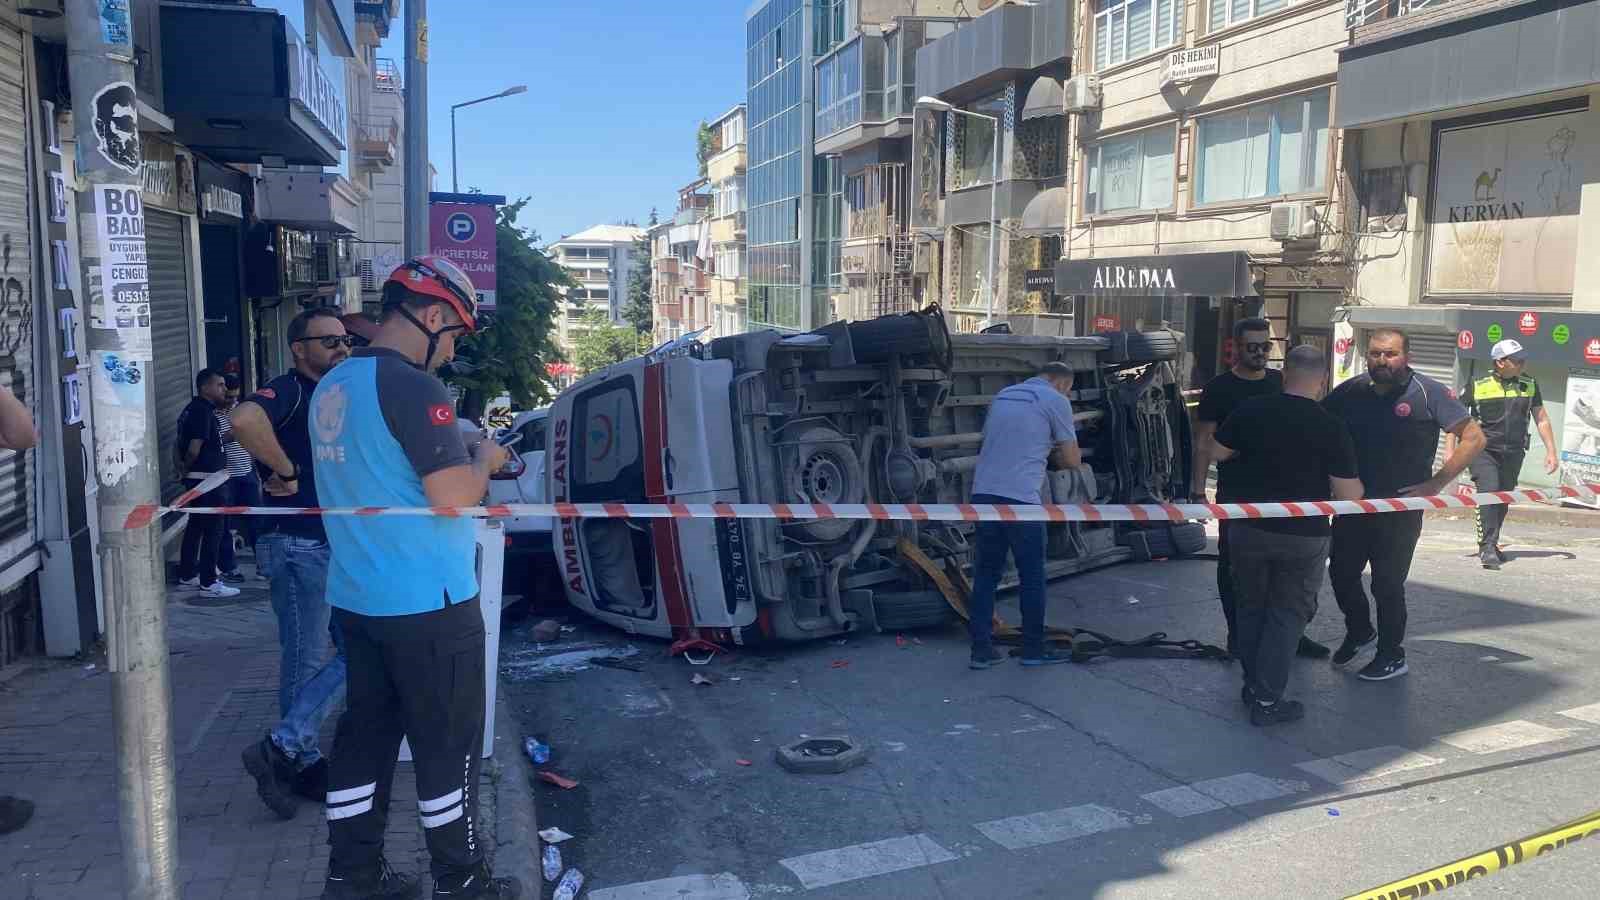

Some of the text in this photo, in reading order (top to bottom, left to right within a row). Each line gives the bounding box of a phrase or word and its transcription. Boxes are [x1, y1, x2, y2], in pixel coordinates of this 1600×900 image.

[1448, 201, 1525, 222] KERVAN
[434, 248, 489, 260] ÜCRETSİZ
[462, 264, 495, 272] ALANI
[736, 575, 745, 592] 34
